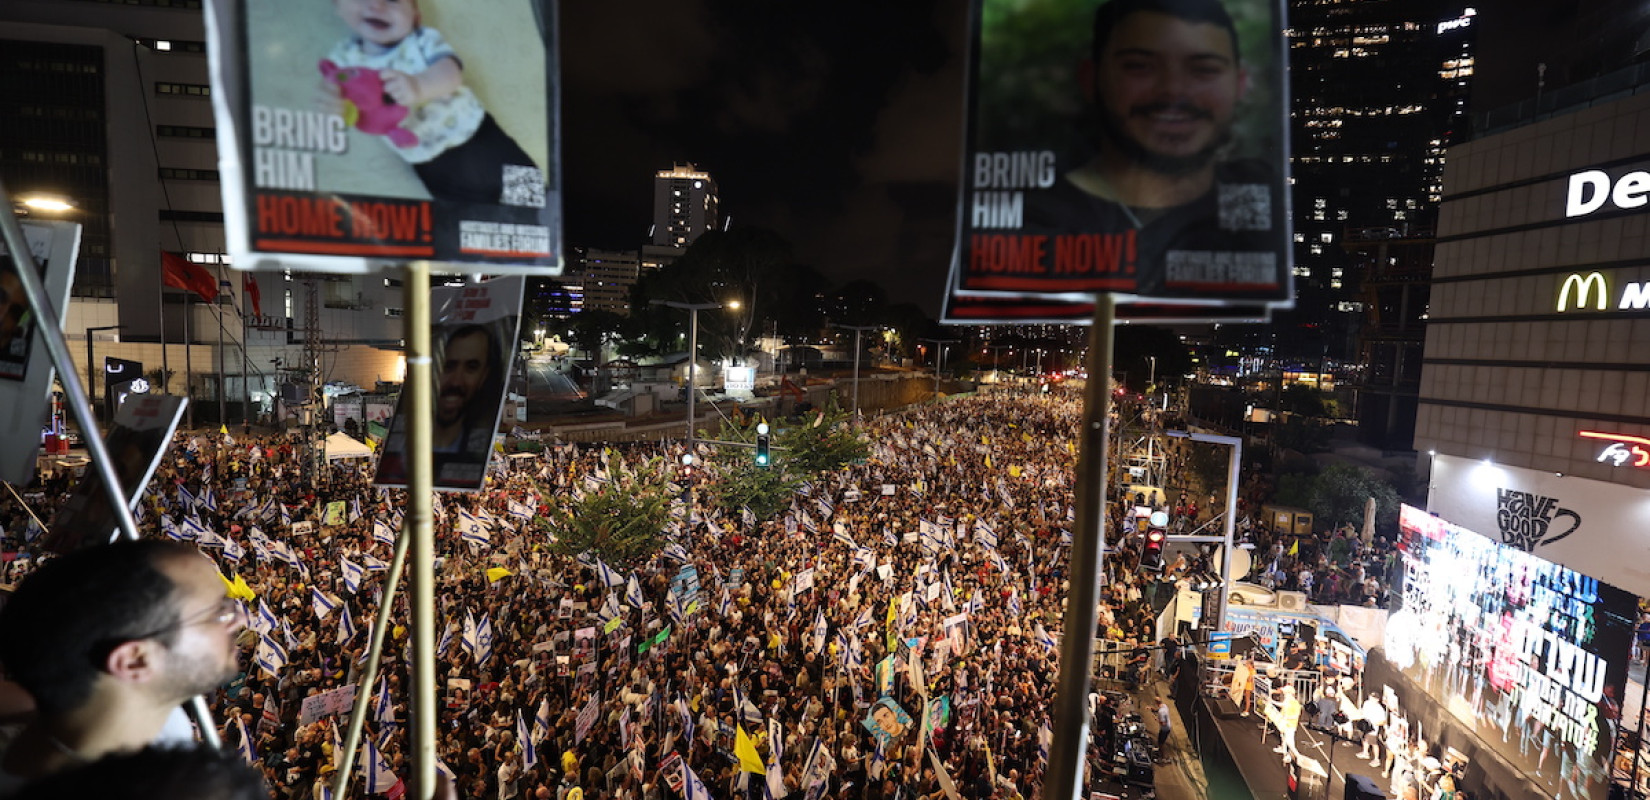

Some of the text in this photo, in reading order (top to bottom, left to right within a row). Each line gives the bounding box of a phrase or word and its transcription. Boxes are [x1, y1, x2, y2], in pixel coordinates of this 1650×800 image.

[1437, 18, 1471, 34] pwc
[254, 106, 346, 152] BRING
[254, 149, 313, 190] HIM
[974, 150, 1055, 189] BRING
[971, 191, 1024, 229] HIM
[1566, 170, 1650, 217] De
[258, 195, 434, 242] HOME NOW!
[461, 232, 550, 253] FAMILIES FORUM
[970, 229, 1138, 275] HOME NOW!
[1166, 263, 1225, 282] FAMILIES
[1497, 509, 1549, 539] GOOD
[1501, 531, 1540, 553] DAY
